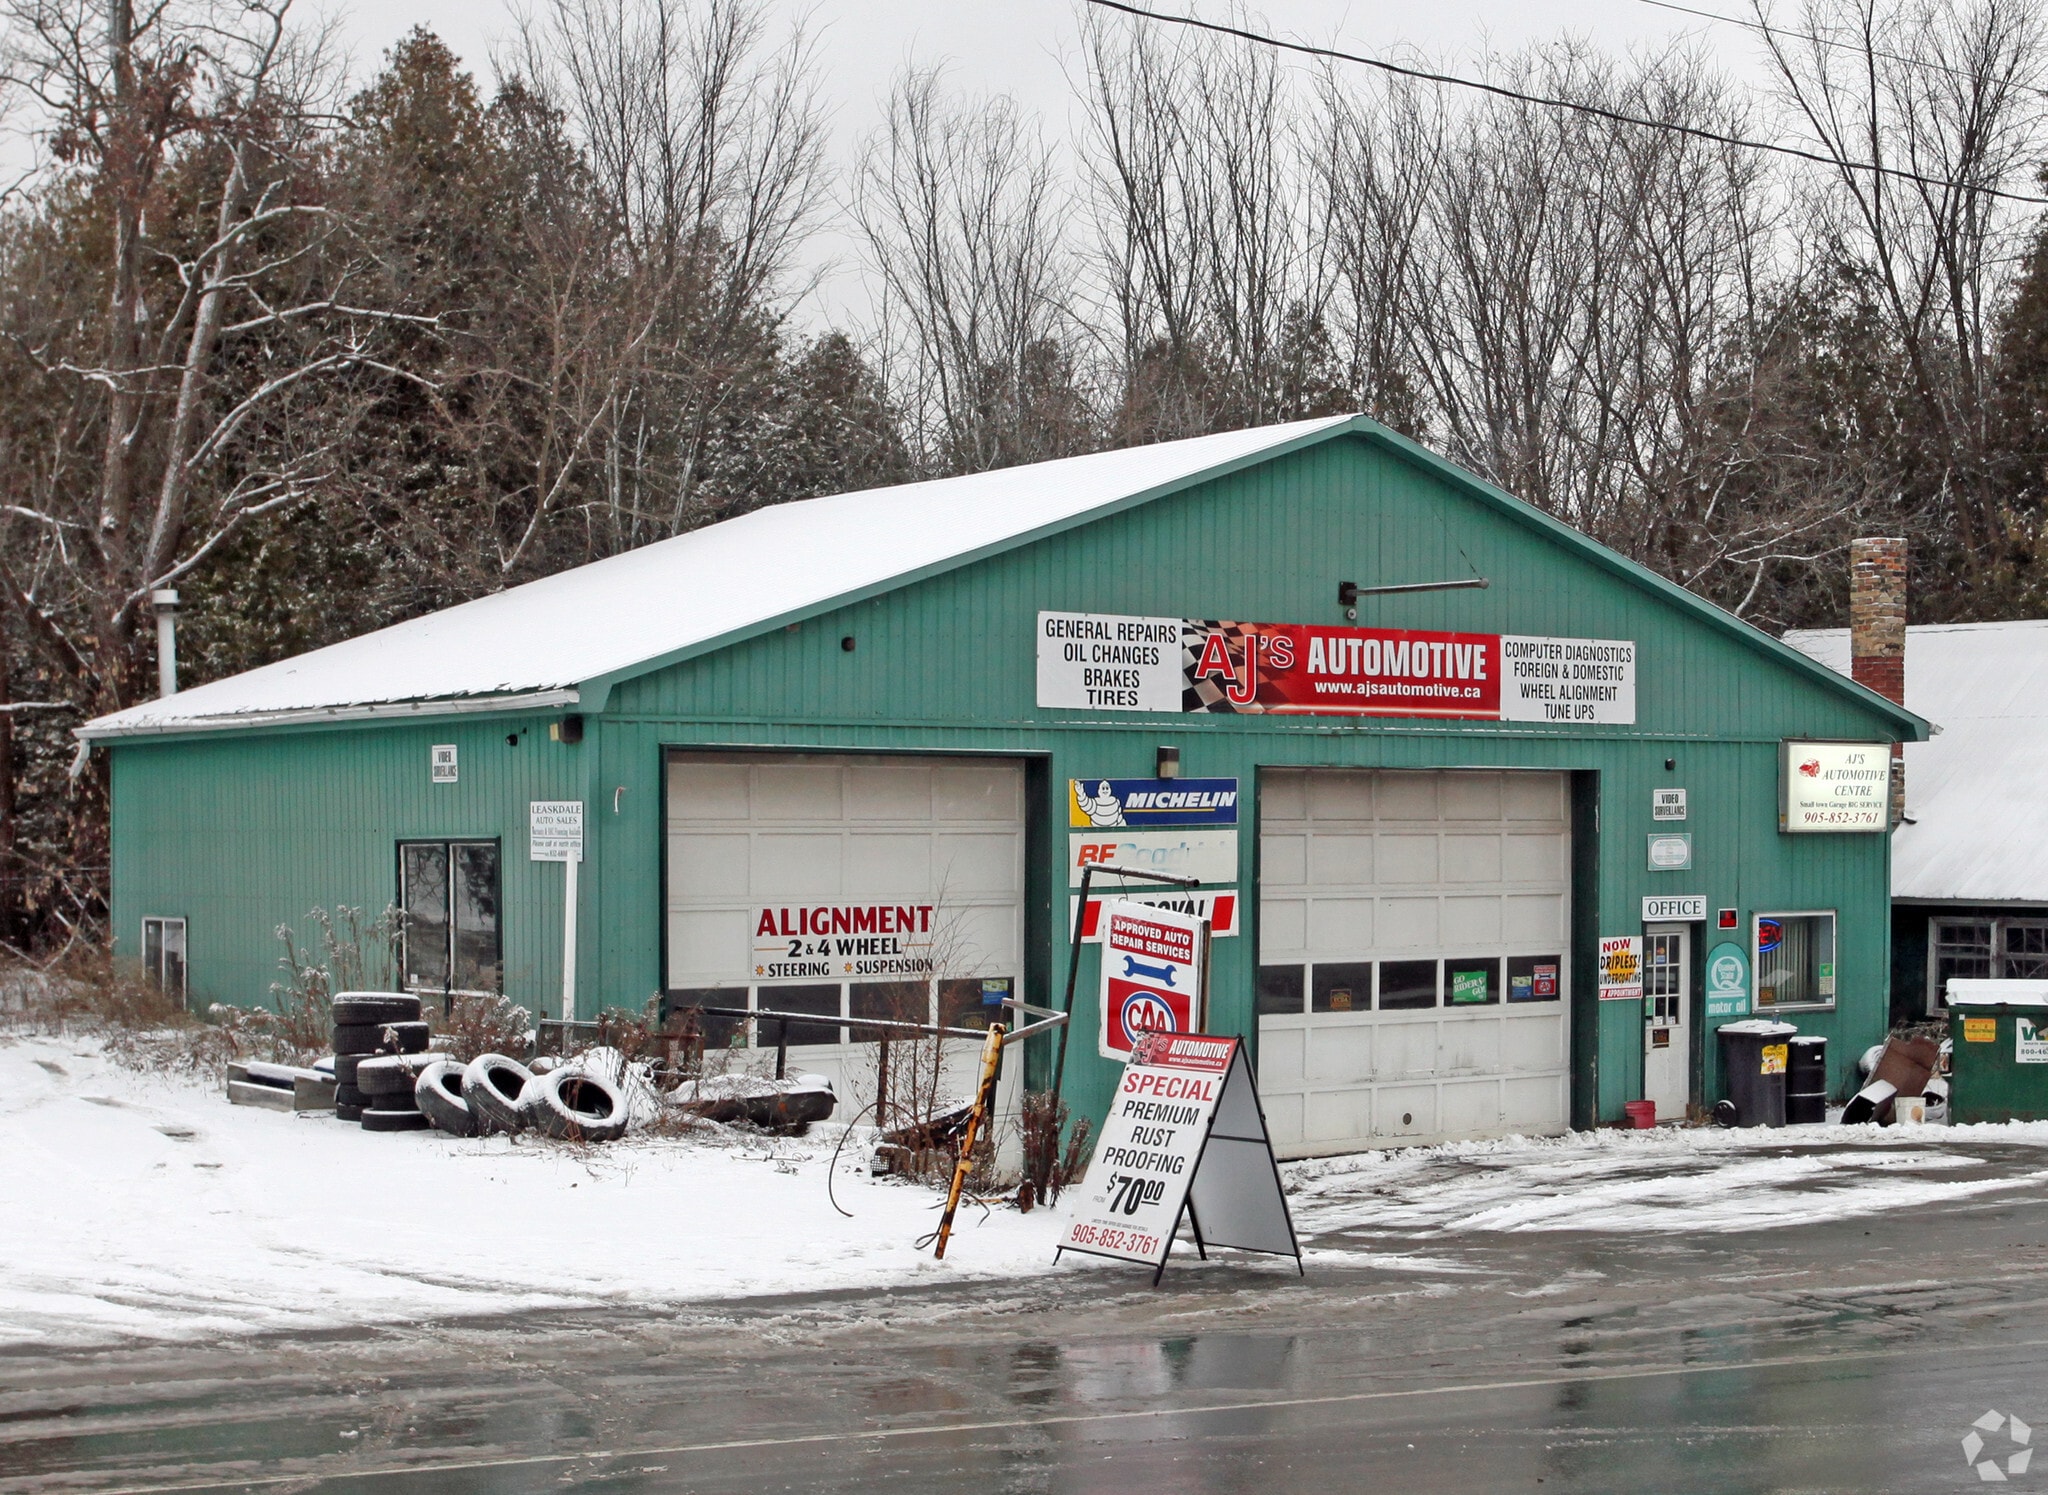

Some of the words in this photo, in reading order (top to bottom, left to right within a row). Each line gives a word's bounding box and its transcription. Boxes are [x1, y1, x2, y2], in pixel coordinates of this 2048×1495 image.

[1045, 619, 1112, 640] GENERAL
[1117, 623, 1177, 643] REPAIRS
[1063, 643, 1087, 661] OIL
[1092, 645, 1159, 665] CHANGES
[1307, 637, 1487, 681] AUTOMOTIVE
[1505, 641, 1562, 660] COMPUTER
[1566, 645, 1632, 662] DIAGNOSTICS
[1084, 668, 1140, 688] BRAKES
[1514, 662, 1558, 679] FOREIGN
[1562, 664, 1570, 679] &
[1573, 664, 1624, 681] DOMESTIC
[1086, 689, 1138, 706] TIRES
[1315, 681, 1481, 699] www.ajsautomotive.ca
[1520, 683, 1556, 701] WHEEL
[1560, 684, 1617, 702] ALIGNMENT
[1544, 703, 1572, 720] TUNE
[1574, 705, 1595, 720] UPS
[1822, 770, 1887, 781] AUTOMOTIVE
[1661, 794, 1679, 804] VIDEO
[1835, 785, 1873, 796] CENTRE
[1125, 792, 1237, 808] MICHELIN
[1829, 801, 1847, 809] Garage
[532, 805, 581, 815] LEASKDALE
[1655, 805, 1685, 816] SURVEILLANCE
[1804, 812, 1879, 823] 905-852-3761
[536, 816, 554, 824] AUTO
[556, 816, 578, 824] SALES
[1648, 900, 1701, 916] OFFICE
[756, 905, 933, 937] ALIGNMENT
[1113, 921, 1162, 940] APPROVED
[1164, 931, 1190, 946] AUTO
[788, 939, 802, 957] 2
[805, 944, 814, 955] &
[817, 939, 831, 956] 4
[836, 937, 902, 956] WHEEL
[1112, 934, 1144, 951] REPAIR
[1145, 940, 1190, 960] SERVICES
[1602, 938, 1631, 953] NOW
[768, 962, 830, 977] STEERING
[856, 958, 933, 975] SUSPENSION
[1600, 954, 1641, 970] DRIPLESS!
[1453, 975, 1465, 985] GO
[1599, 972, 1641, 985] UNDERCOATING
[1607, 988, 1641, 998] APPOINTMENT
[1709, 1001, 1732, 1014] motor
[1736, 999, 1746, 1012] oil
[1128, 1000, 1167, 1032] CAA
[1168, 1039, 1229, 1059] AUTOMOTIVE
[1123, 1073, 1213, 1102] SPECIAL
[1122, 1100, 1200, 1126] PREMIUM
[1130, 1126, 1175, 1148] RUST
[1103, 1147, 1185, 1175] PROOFING
[1071, 1223, 1160, 1255] 905-852-3761
